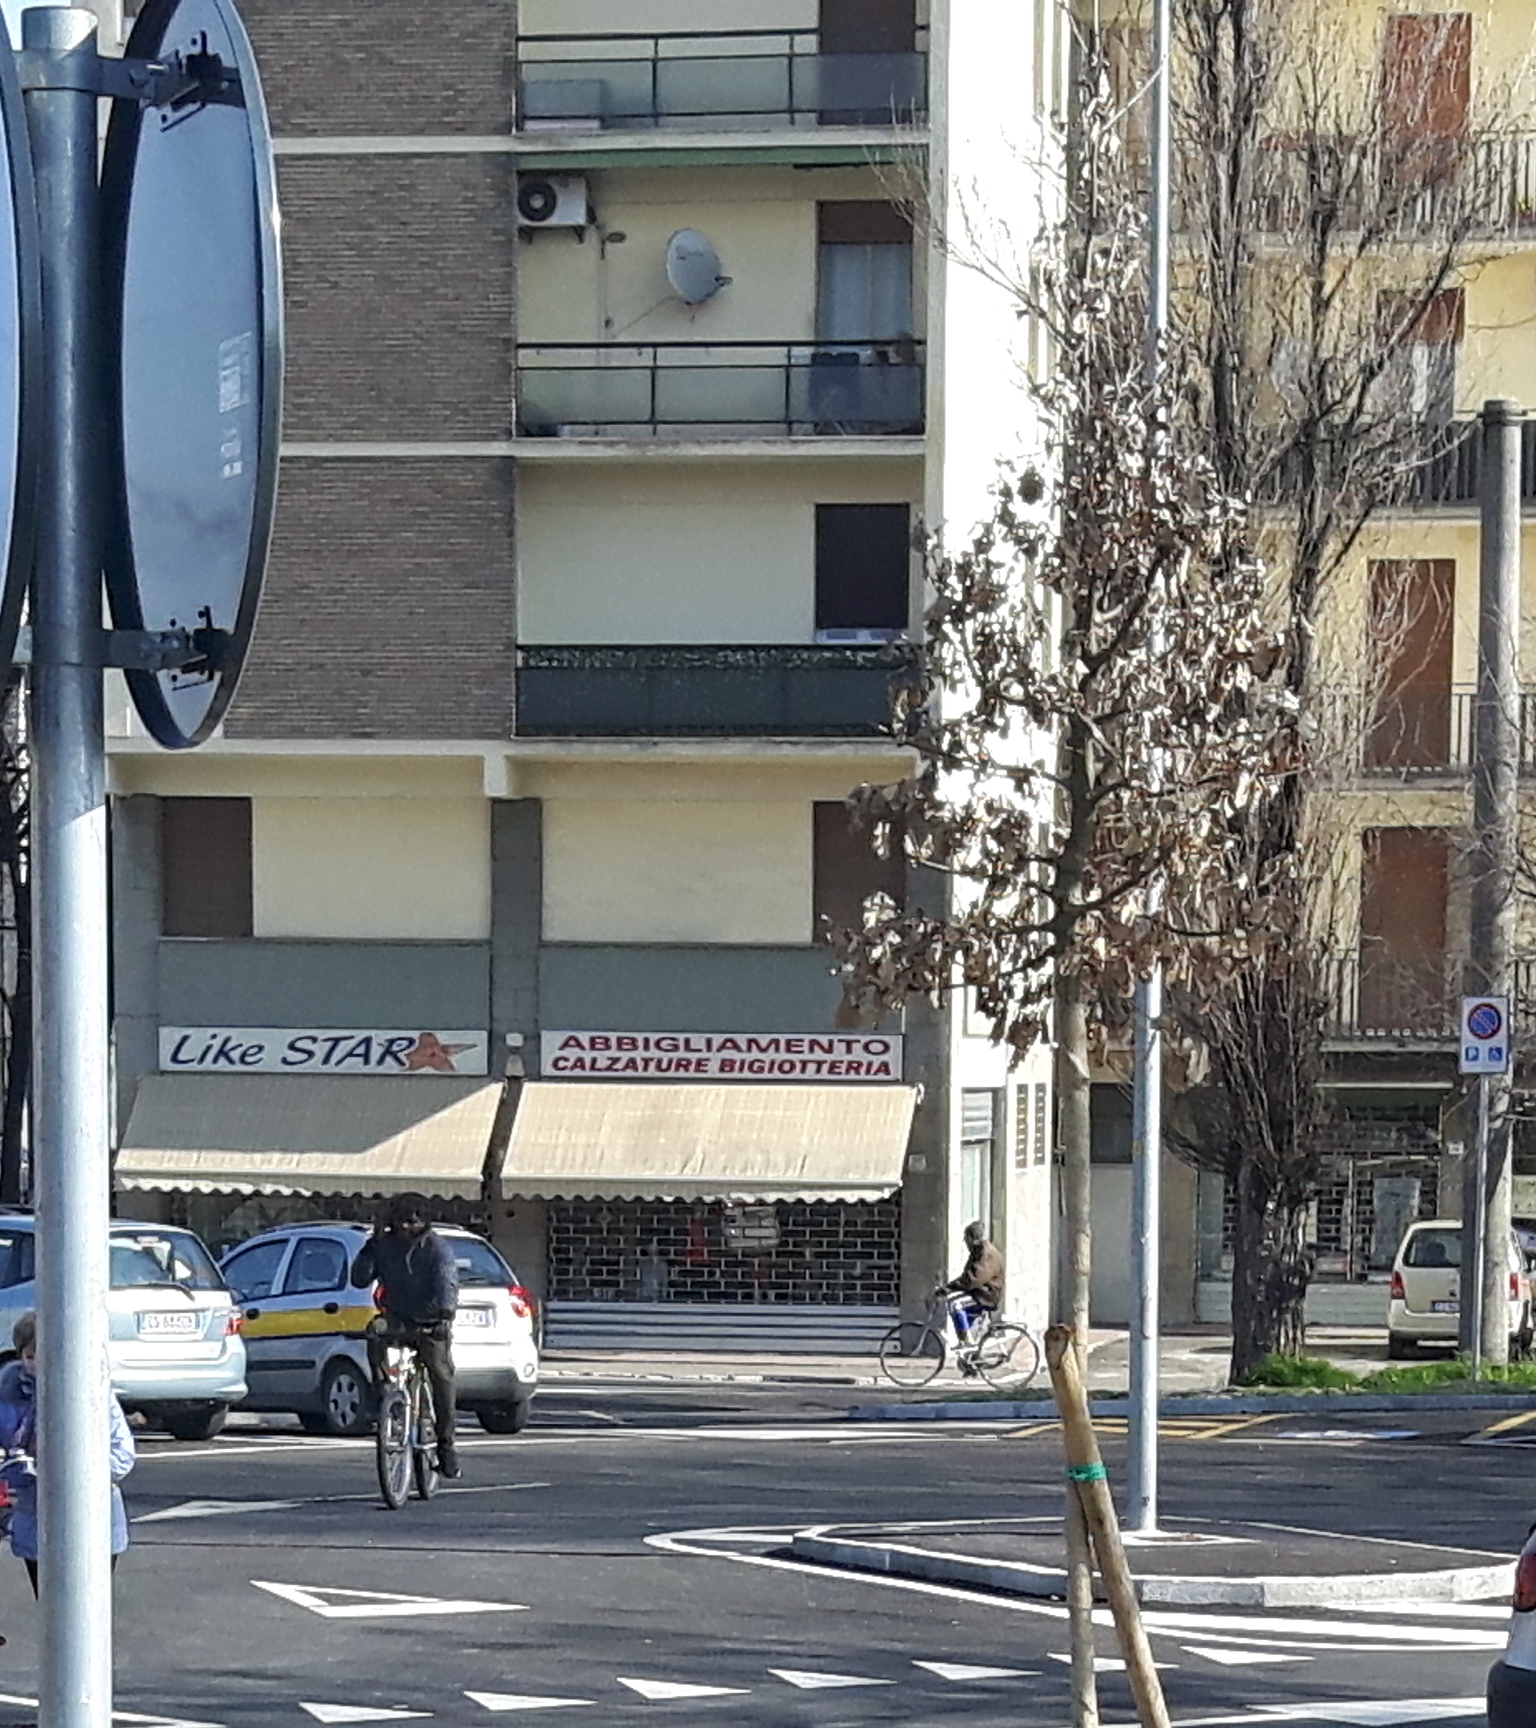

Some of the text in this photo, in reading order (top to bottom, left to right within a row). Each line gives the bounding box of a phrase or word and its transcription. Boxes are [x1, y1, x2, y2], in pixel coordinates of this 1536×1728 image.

[169, 1033, 417, 1067] Like STAR
[558, 1035, 891, 1056] ABBIGLIAMENTO
[551, 1056, 891, 1077] CALZATURE BIGIOTTERIA
